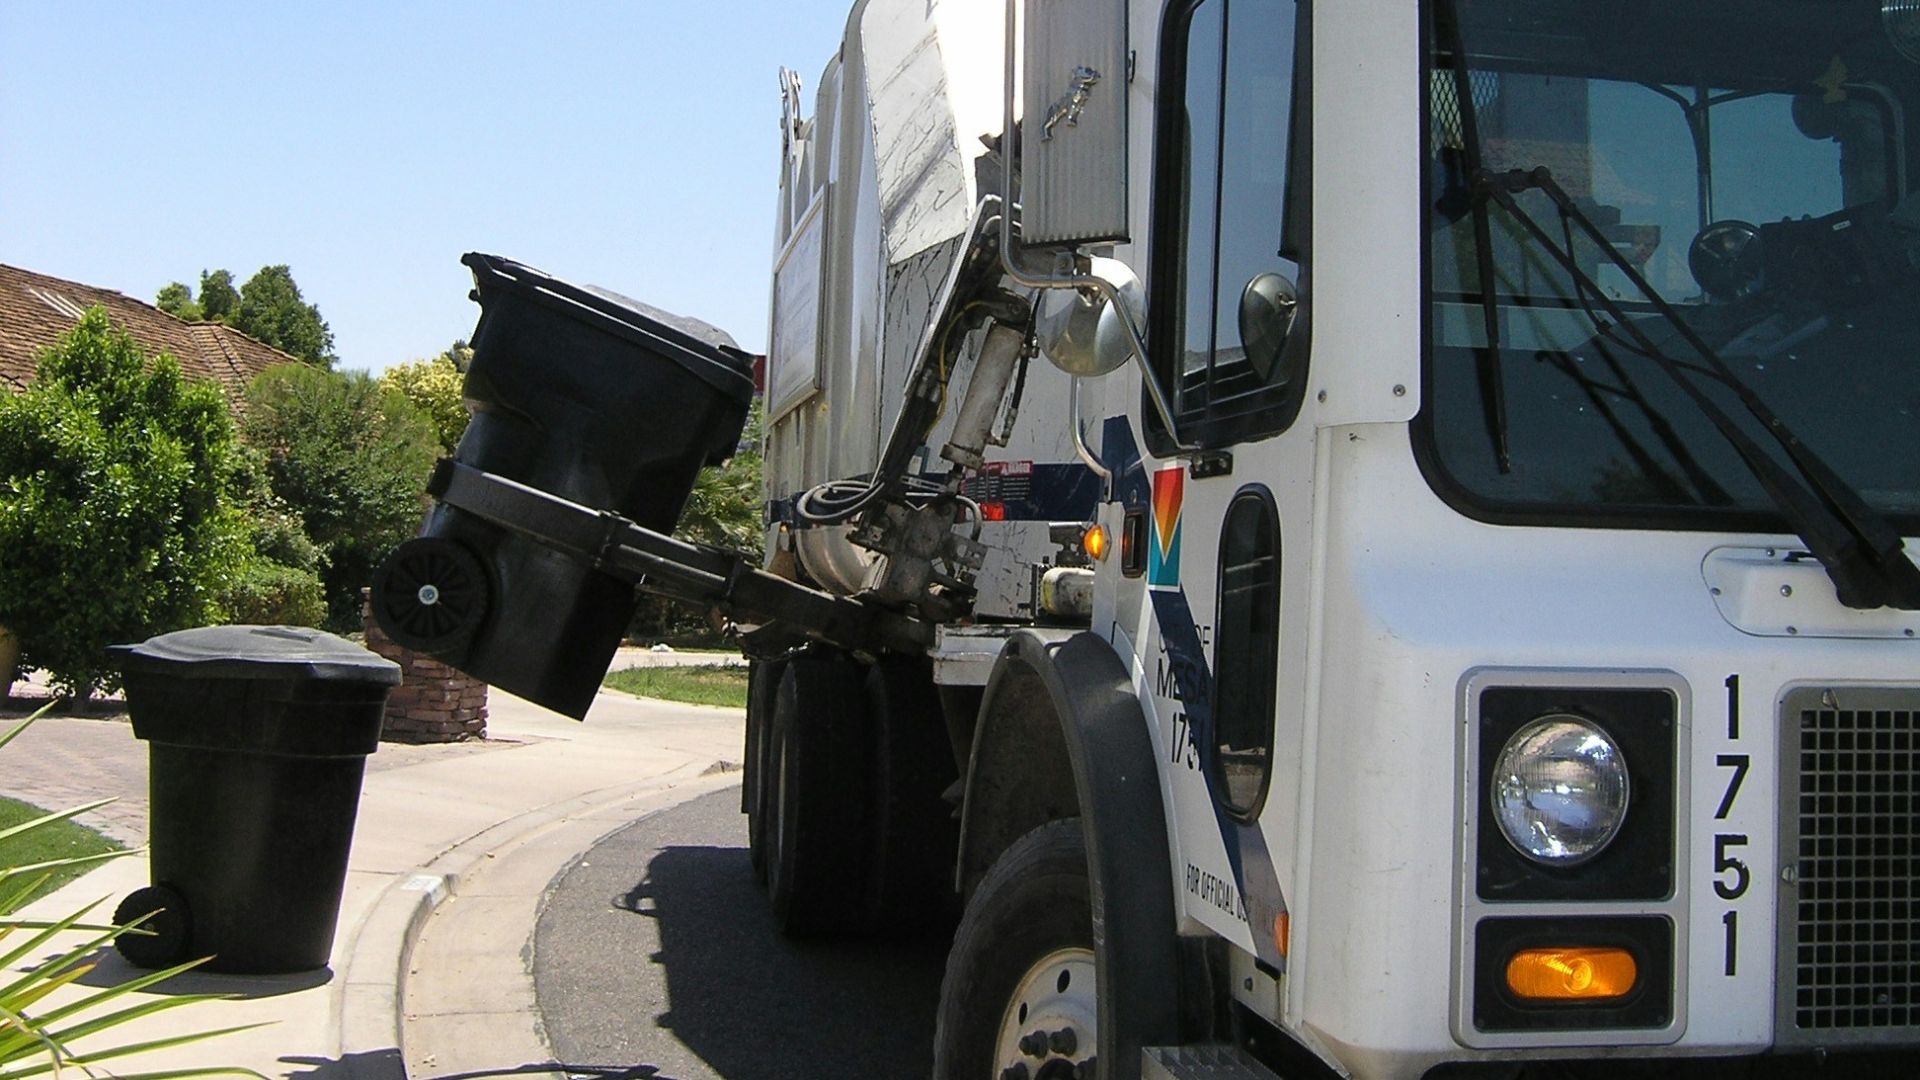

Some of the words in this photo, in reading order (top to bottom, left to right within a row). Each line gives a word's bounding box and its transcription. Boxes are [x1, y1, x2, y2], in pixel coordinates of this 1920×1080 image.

[1186, 863, 1200, 895] FOR
[1201, 871, 1235, 916] OFFICIAL
[1713, 674, 1750, 976] 1751
